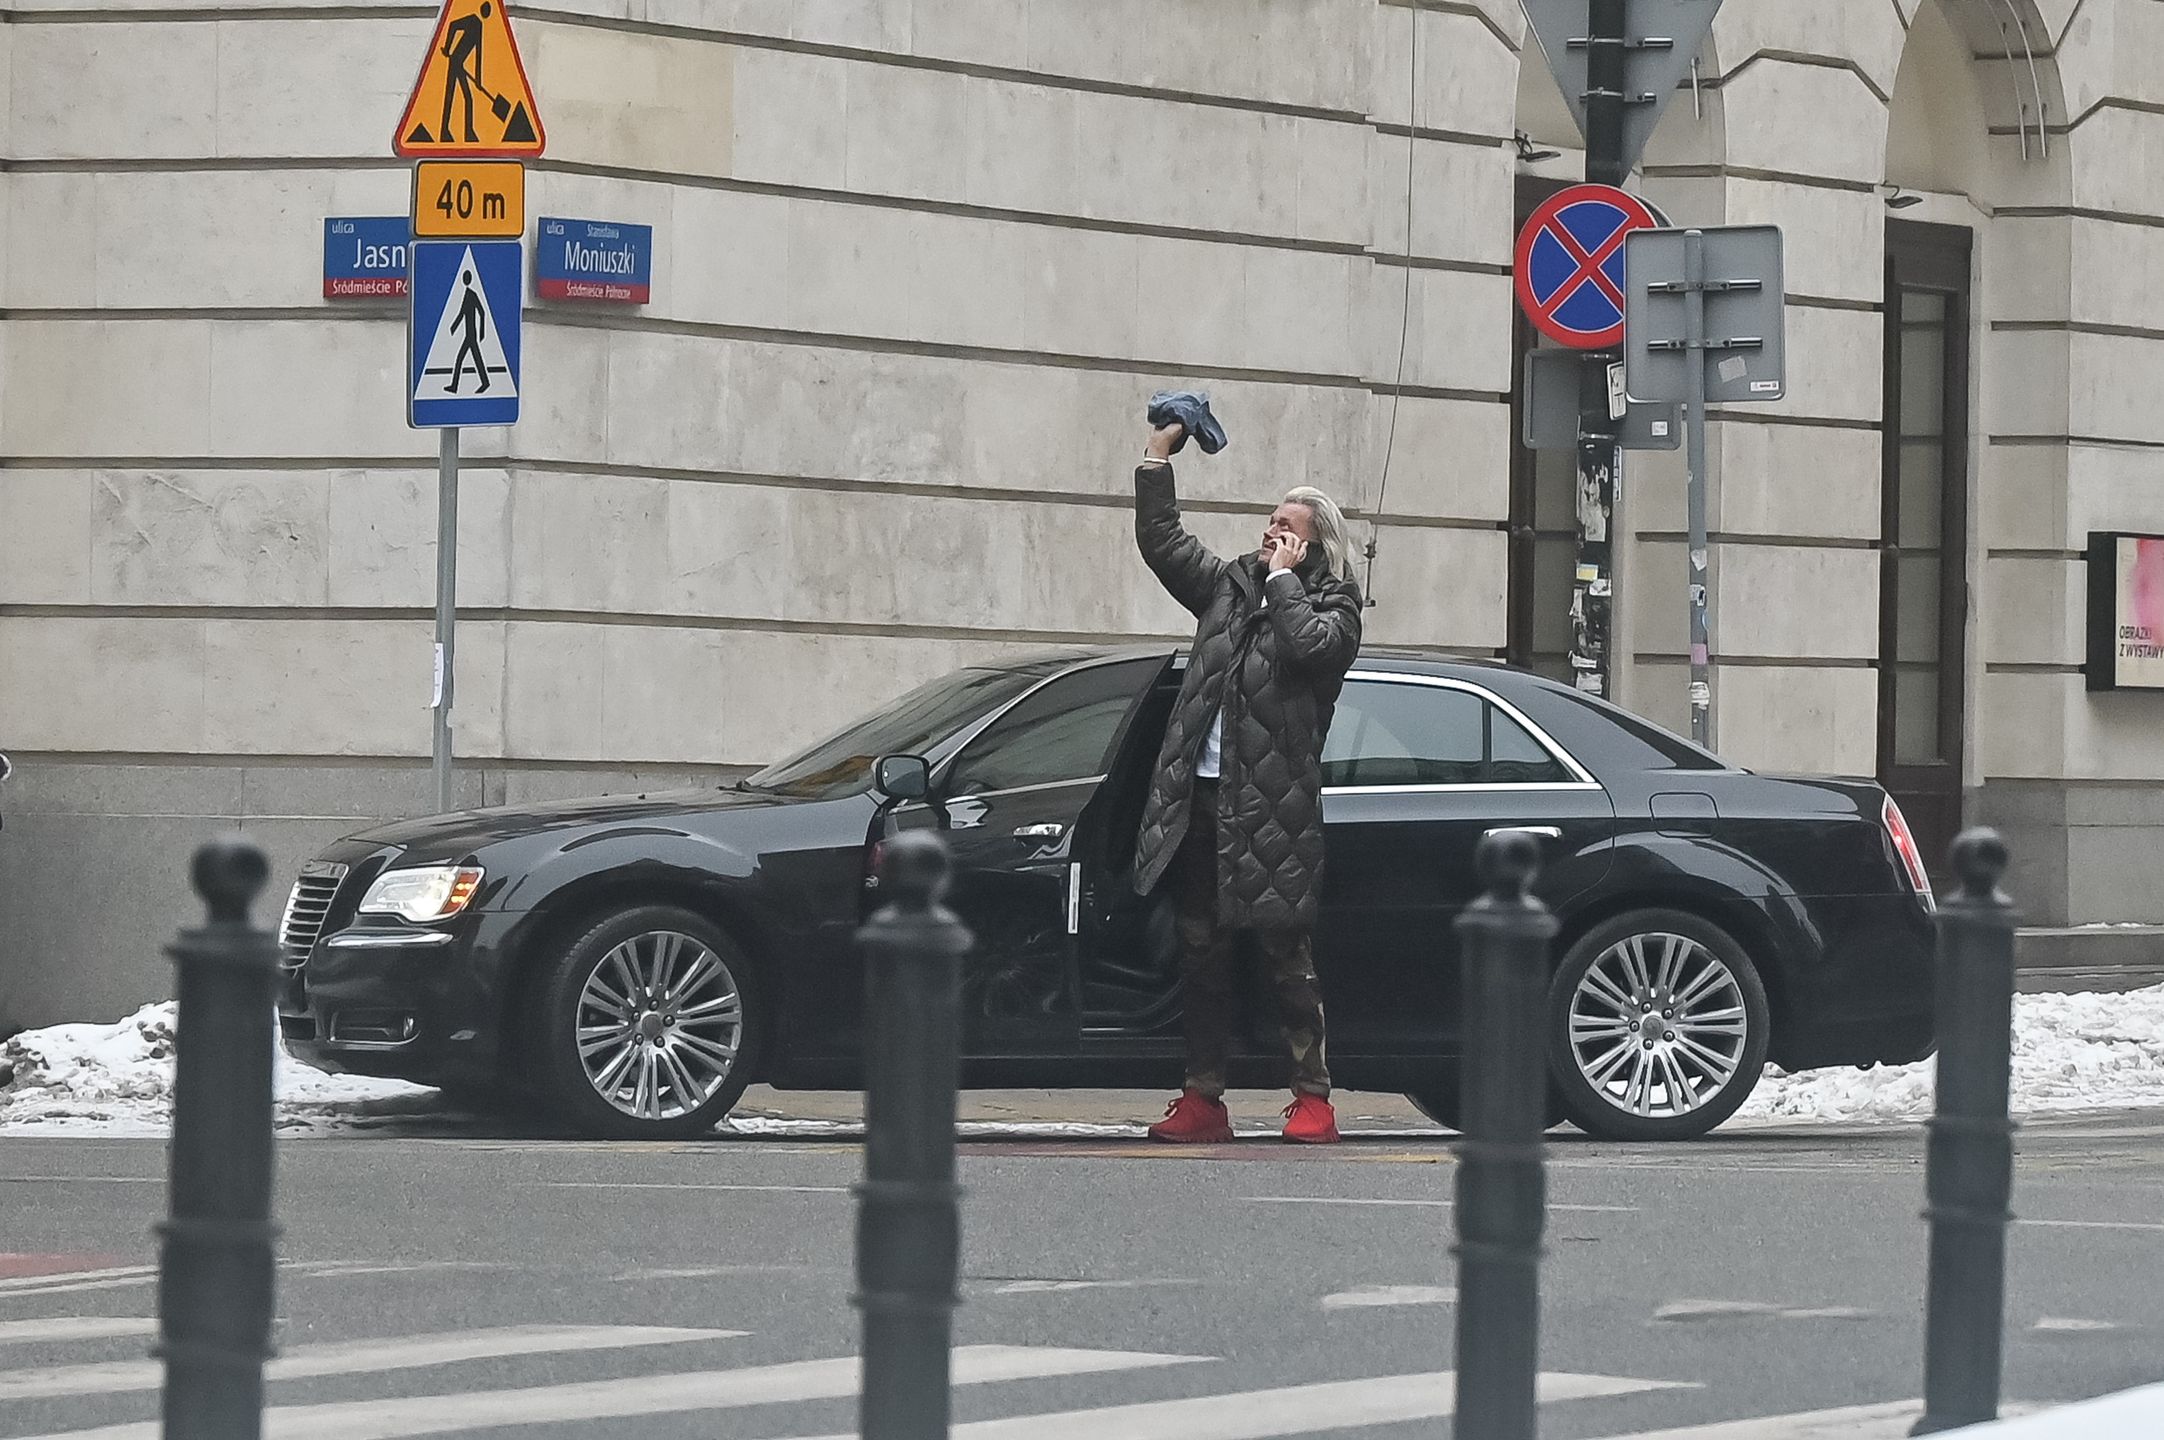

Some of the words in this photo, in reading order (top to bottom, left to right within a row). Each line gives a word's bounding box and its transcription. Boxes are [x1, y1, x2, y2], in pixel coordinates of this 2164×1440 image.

[436, 179, 473, 219] 40
[483, 193, 505, 219] m
[332, 220, 355, 234] ulica
[353, 238, 406, 268] Jasn
[564, 240, 635, 274] Moniuszki
[332, 278, 391, 294] Śródmieście
[2119, 643, 2125, 657] Z
